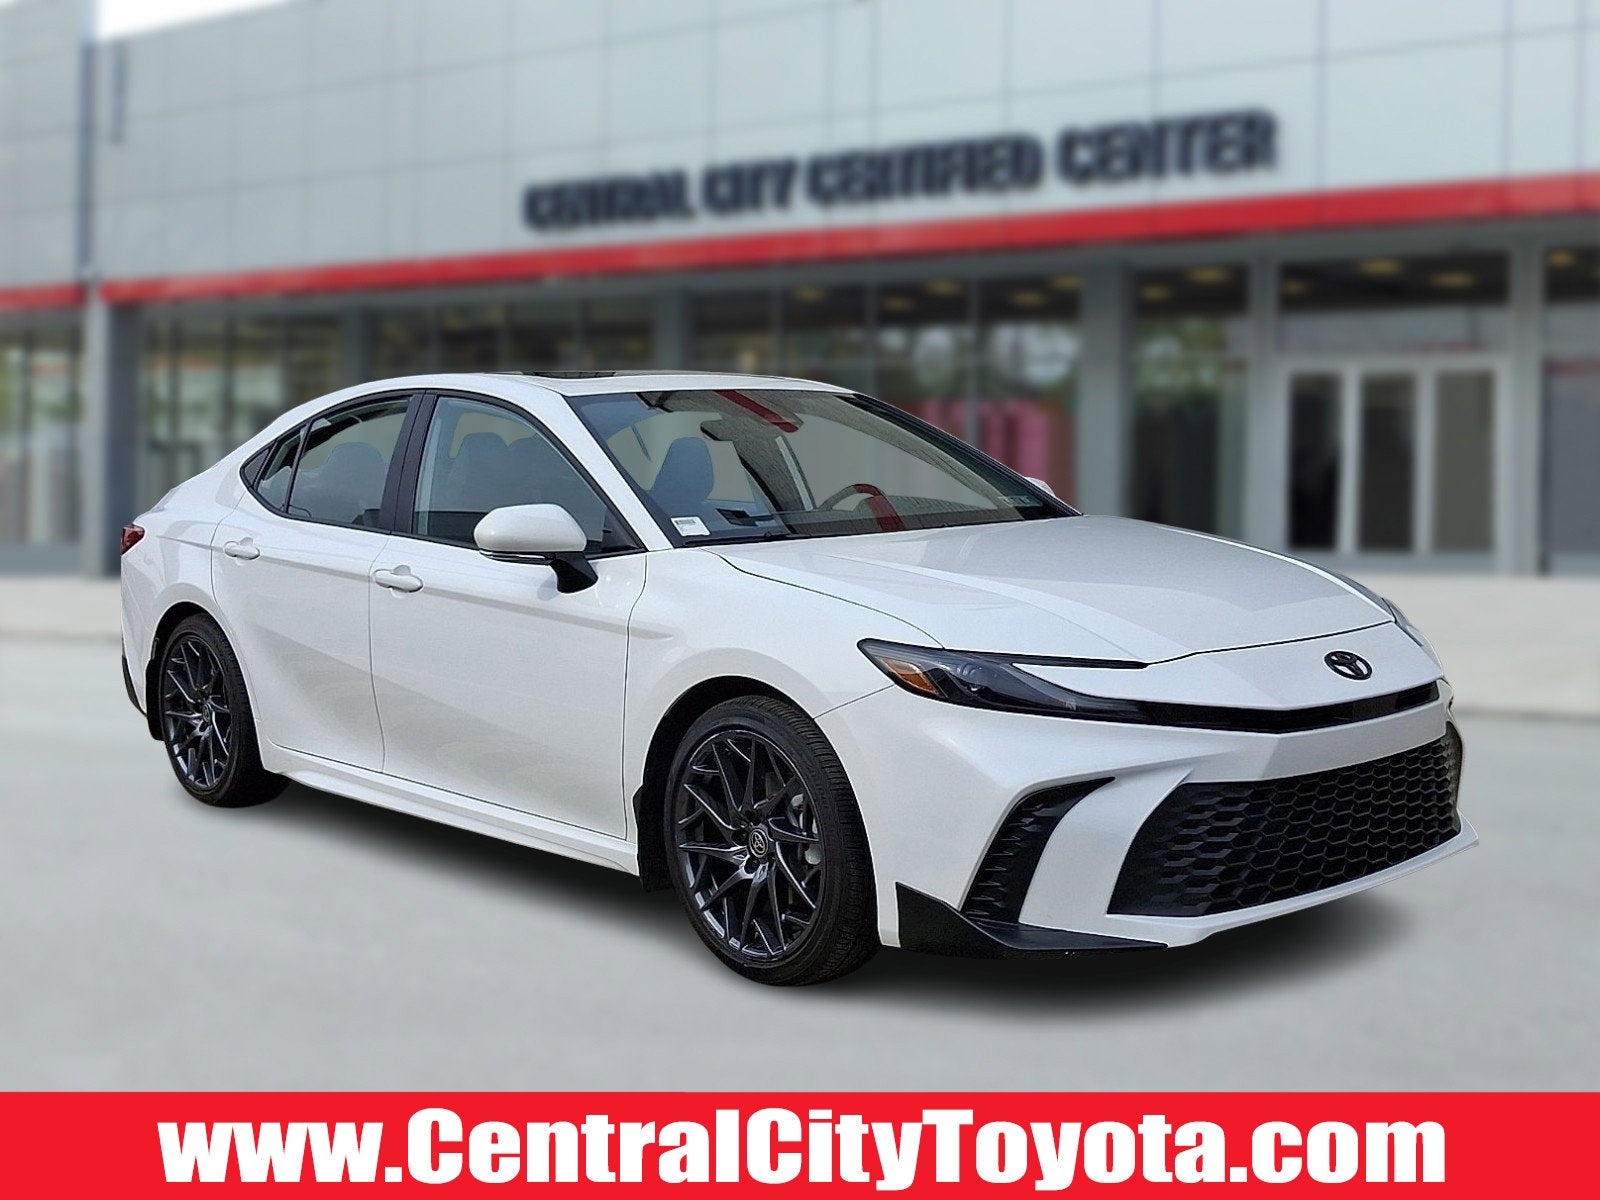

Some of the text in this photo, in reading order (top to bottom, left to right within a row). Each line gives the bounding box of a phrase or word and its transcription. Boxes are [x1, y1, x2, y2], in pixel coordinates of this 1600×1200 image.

[523, 169, 697, 232] CENTRAL
[702, 155, 799, 215] CITY
[1057, 107, 1278, 187] CENTER
